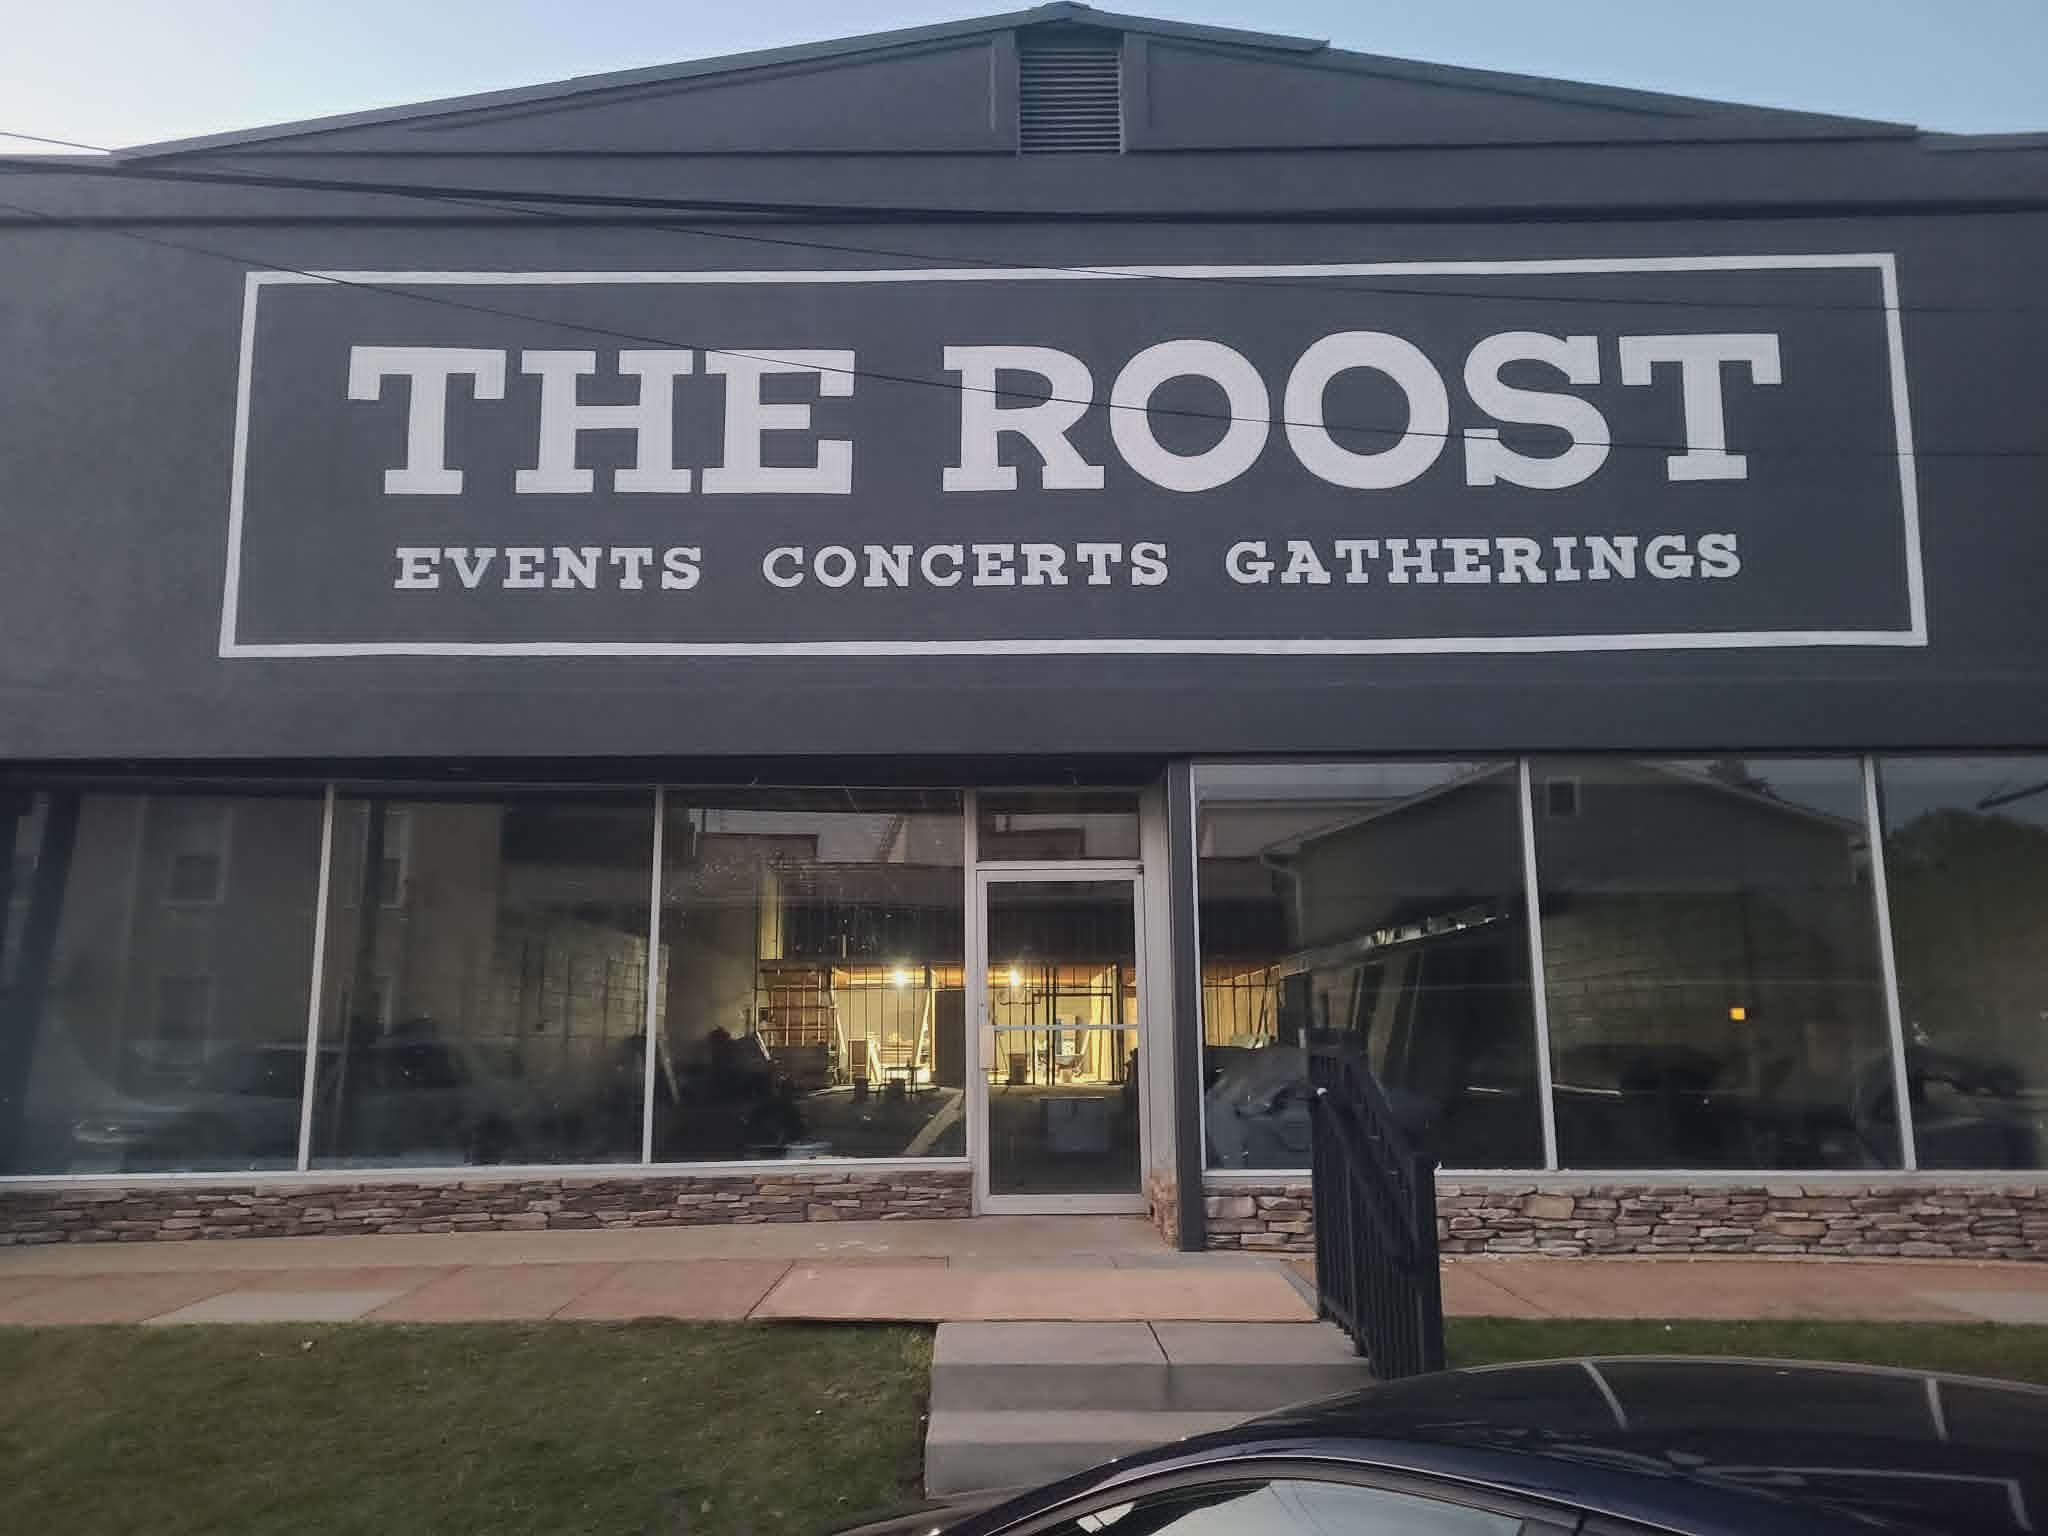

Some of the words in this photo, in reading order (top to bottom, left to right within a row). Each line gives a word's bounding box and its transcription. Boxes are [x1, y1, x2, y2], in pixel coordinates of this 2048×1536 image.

[347, 345, 856, 497] THE
[942, 331, 1782, 493] ROOST
[393, 546, 702, 591] EVENTS
[762, 541, 1169, 588] CONCERTS
[1225, 533, 1741, 585] GATHERINGS
